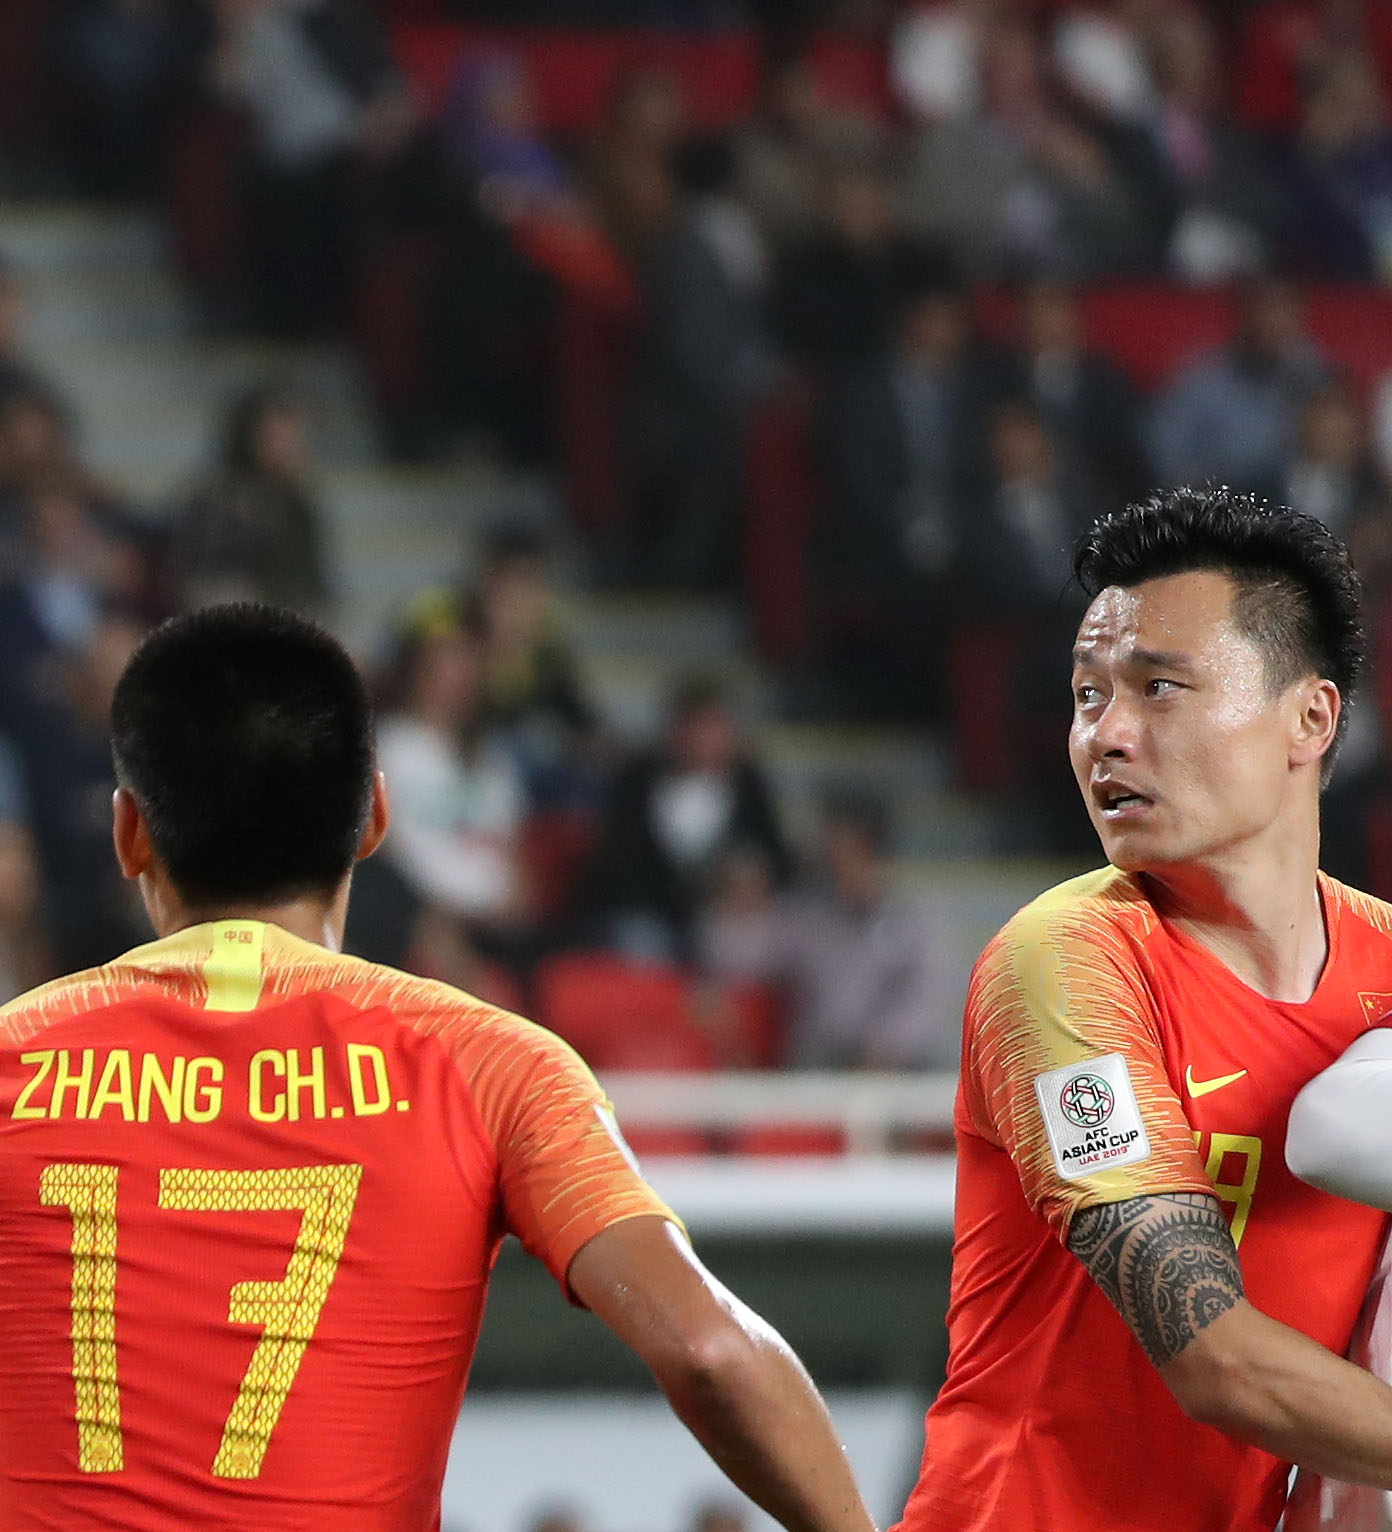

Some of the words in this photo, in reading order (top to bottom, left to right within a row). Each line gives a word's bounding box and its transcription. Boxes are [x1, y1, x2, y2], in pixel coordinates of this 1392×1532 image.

[224, 930, 253, 944] 中国
[11, 1049, 224, 1123] ZHANG
[249, 1043, 411, 1122] CH.D.
[1062, 1139, 1107, 1160] ASIAN
[1109, 1130, 1139, 1147] CUP
[1085, 1127, 1109, 1141] AFC
[1079, 1154, 1101, 1165] UAE
[38, 1163, 364, 1479] 17
